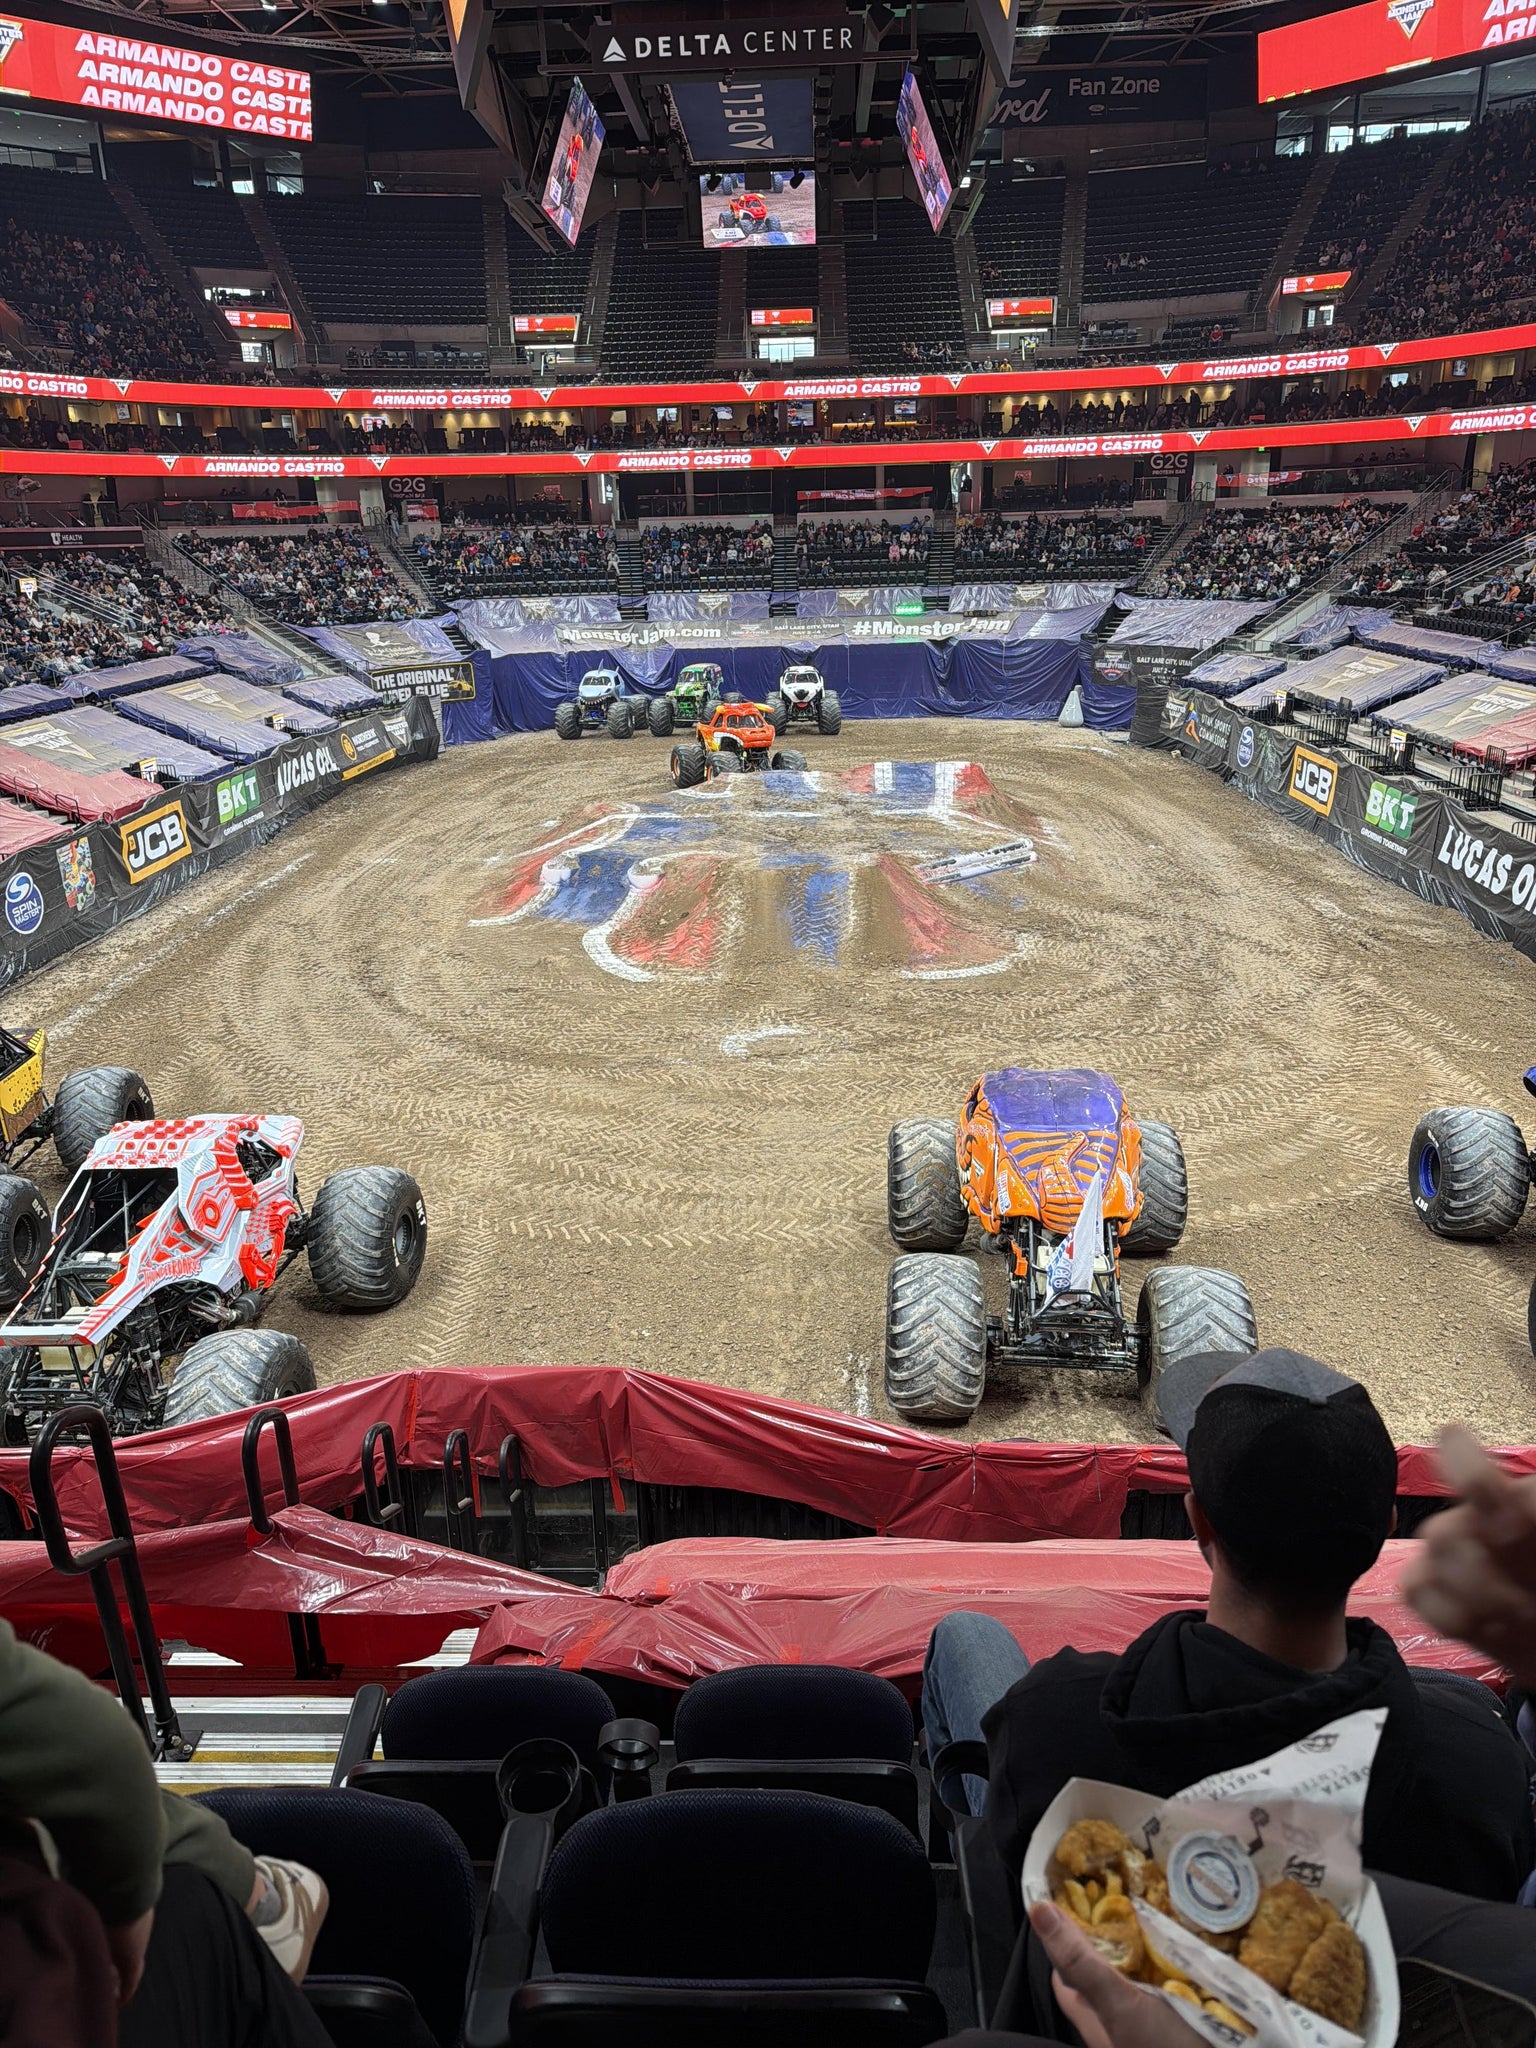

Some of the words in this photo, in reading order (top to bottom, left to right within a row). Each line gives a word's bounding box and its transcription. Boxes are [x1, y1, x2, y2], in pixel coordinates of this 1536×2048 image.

[635, 34, 731, 59] DELTA
[743, 28, 853, 53] CENTER
[75, 33, 222, 77] ARMANDO
[77, 59, 223, 100] ARMANDO
[1068, 78, 1105, 97] Fan
[1110, 76, 1160, 95] Zone
[80, 86, 225, 126] ARMANDO
[1202, 361, 1281, 378] ARMANDO
[1285, 354, 1349, 370] CASTRO
[28, 380, 88, 394] CASTRO
[784, 384, 858, 396] ARMANDO
[861, 382, 921, 393] CASTRO
[372, 395, 448, 405] ARMANDO
[451, 394, 512, 405] CASTRO
[1450, 413, 1526, 431] ARMANDO
[1023, 441, 1098, 454] ARMANDO
[1101, 439, 1163, 450] CASTRO
[205, 462, 280, 473] ARMANDO
[284, 462, 345, 472] CASTRO
[618, 456, 690, 467] ARMANDO
[693, 454, 752, 465] CASTRO
[1150, 453, 1189, 470] G2G
[388, 477, 426, 493] G2G
[562, 627, 721, 645] MonsterJam.com
[851, 617, 1011, 636] #MonsterJam
[1136, 656, 1151, 664] SALT
[1178, 659, 1193, 667] UTAH
[373, 673, 397, 690] THE
[1201, 713, 1215, 726] UTAH
[1214, 718, 1232, 736] SPORTS
[1295, 760, 1333, 803] JCB
[218, 775, 257, 816] BKT
[1366, 788, 1416, 831] BKT
[128, 814, 184, 869] JCB
[1437, 825, 1514, 895] LUCAS
[11, 898, 38, 918] SPIN
[137, 1086, 150, 1104] BKT
[31, 1198, 48, 1220] BKT
[415, 1199, 427, 1226] BKT
